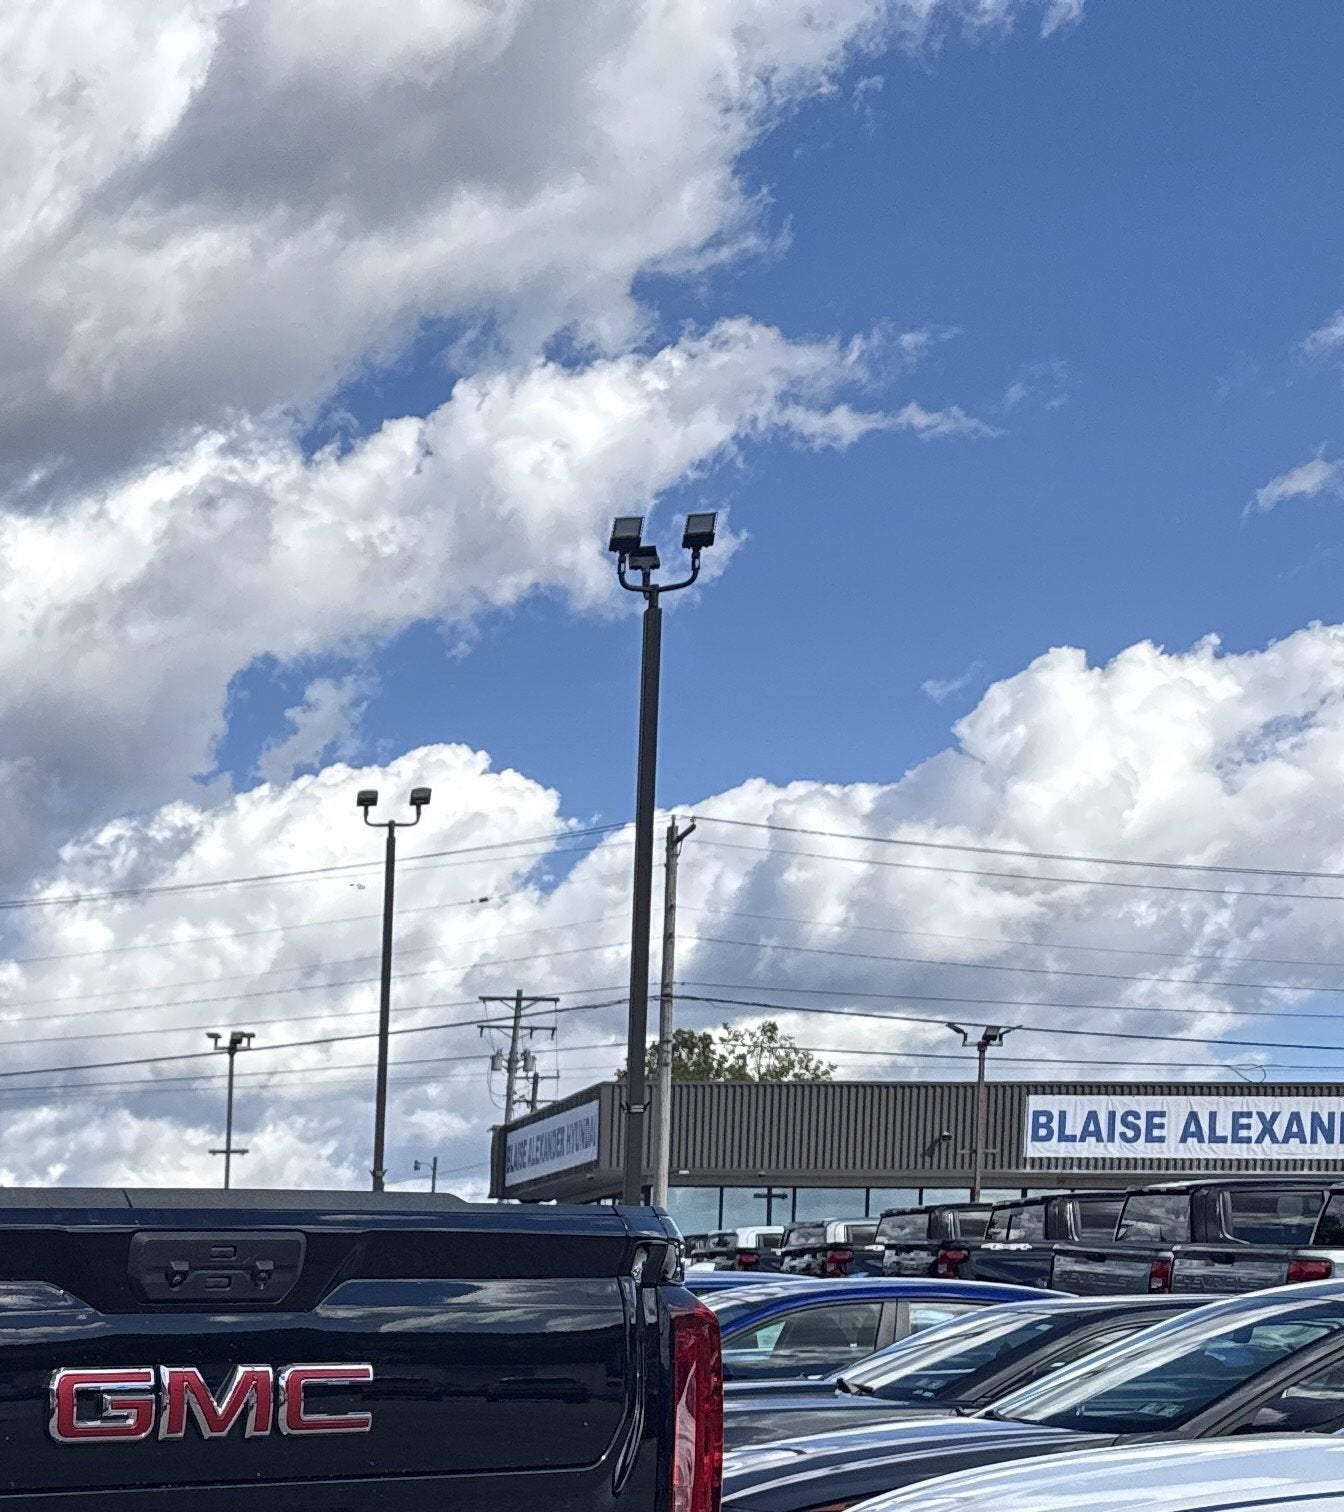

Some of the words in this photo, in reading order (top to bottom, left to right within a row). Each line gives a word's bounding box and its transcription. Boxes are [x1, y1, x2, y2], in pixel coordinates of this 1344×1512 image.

[1031, 1110, 1167, 1143] BLAISE
[1179, 1111, 1344, 1145] ALEXAN
[49, 1362, 374, 1442] GMC
